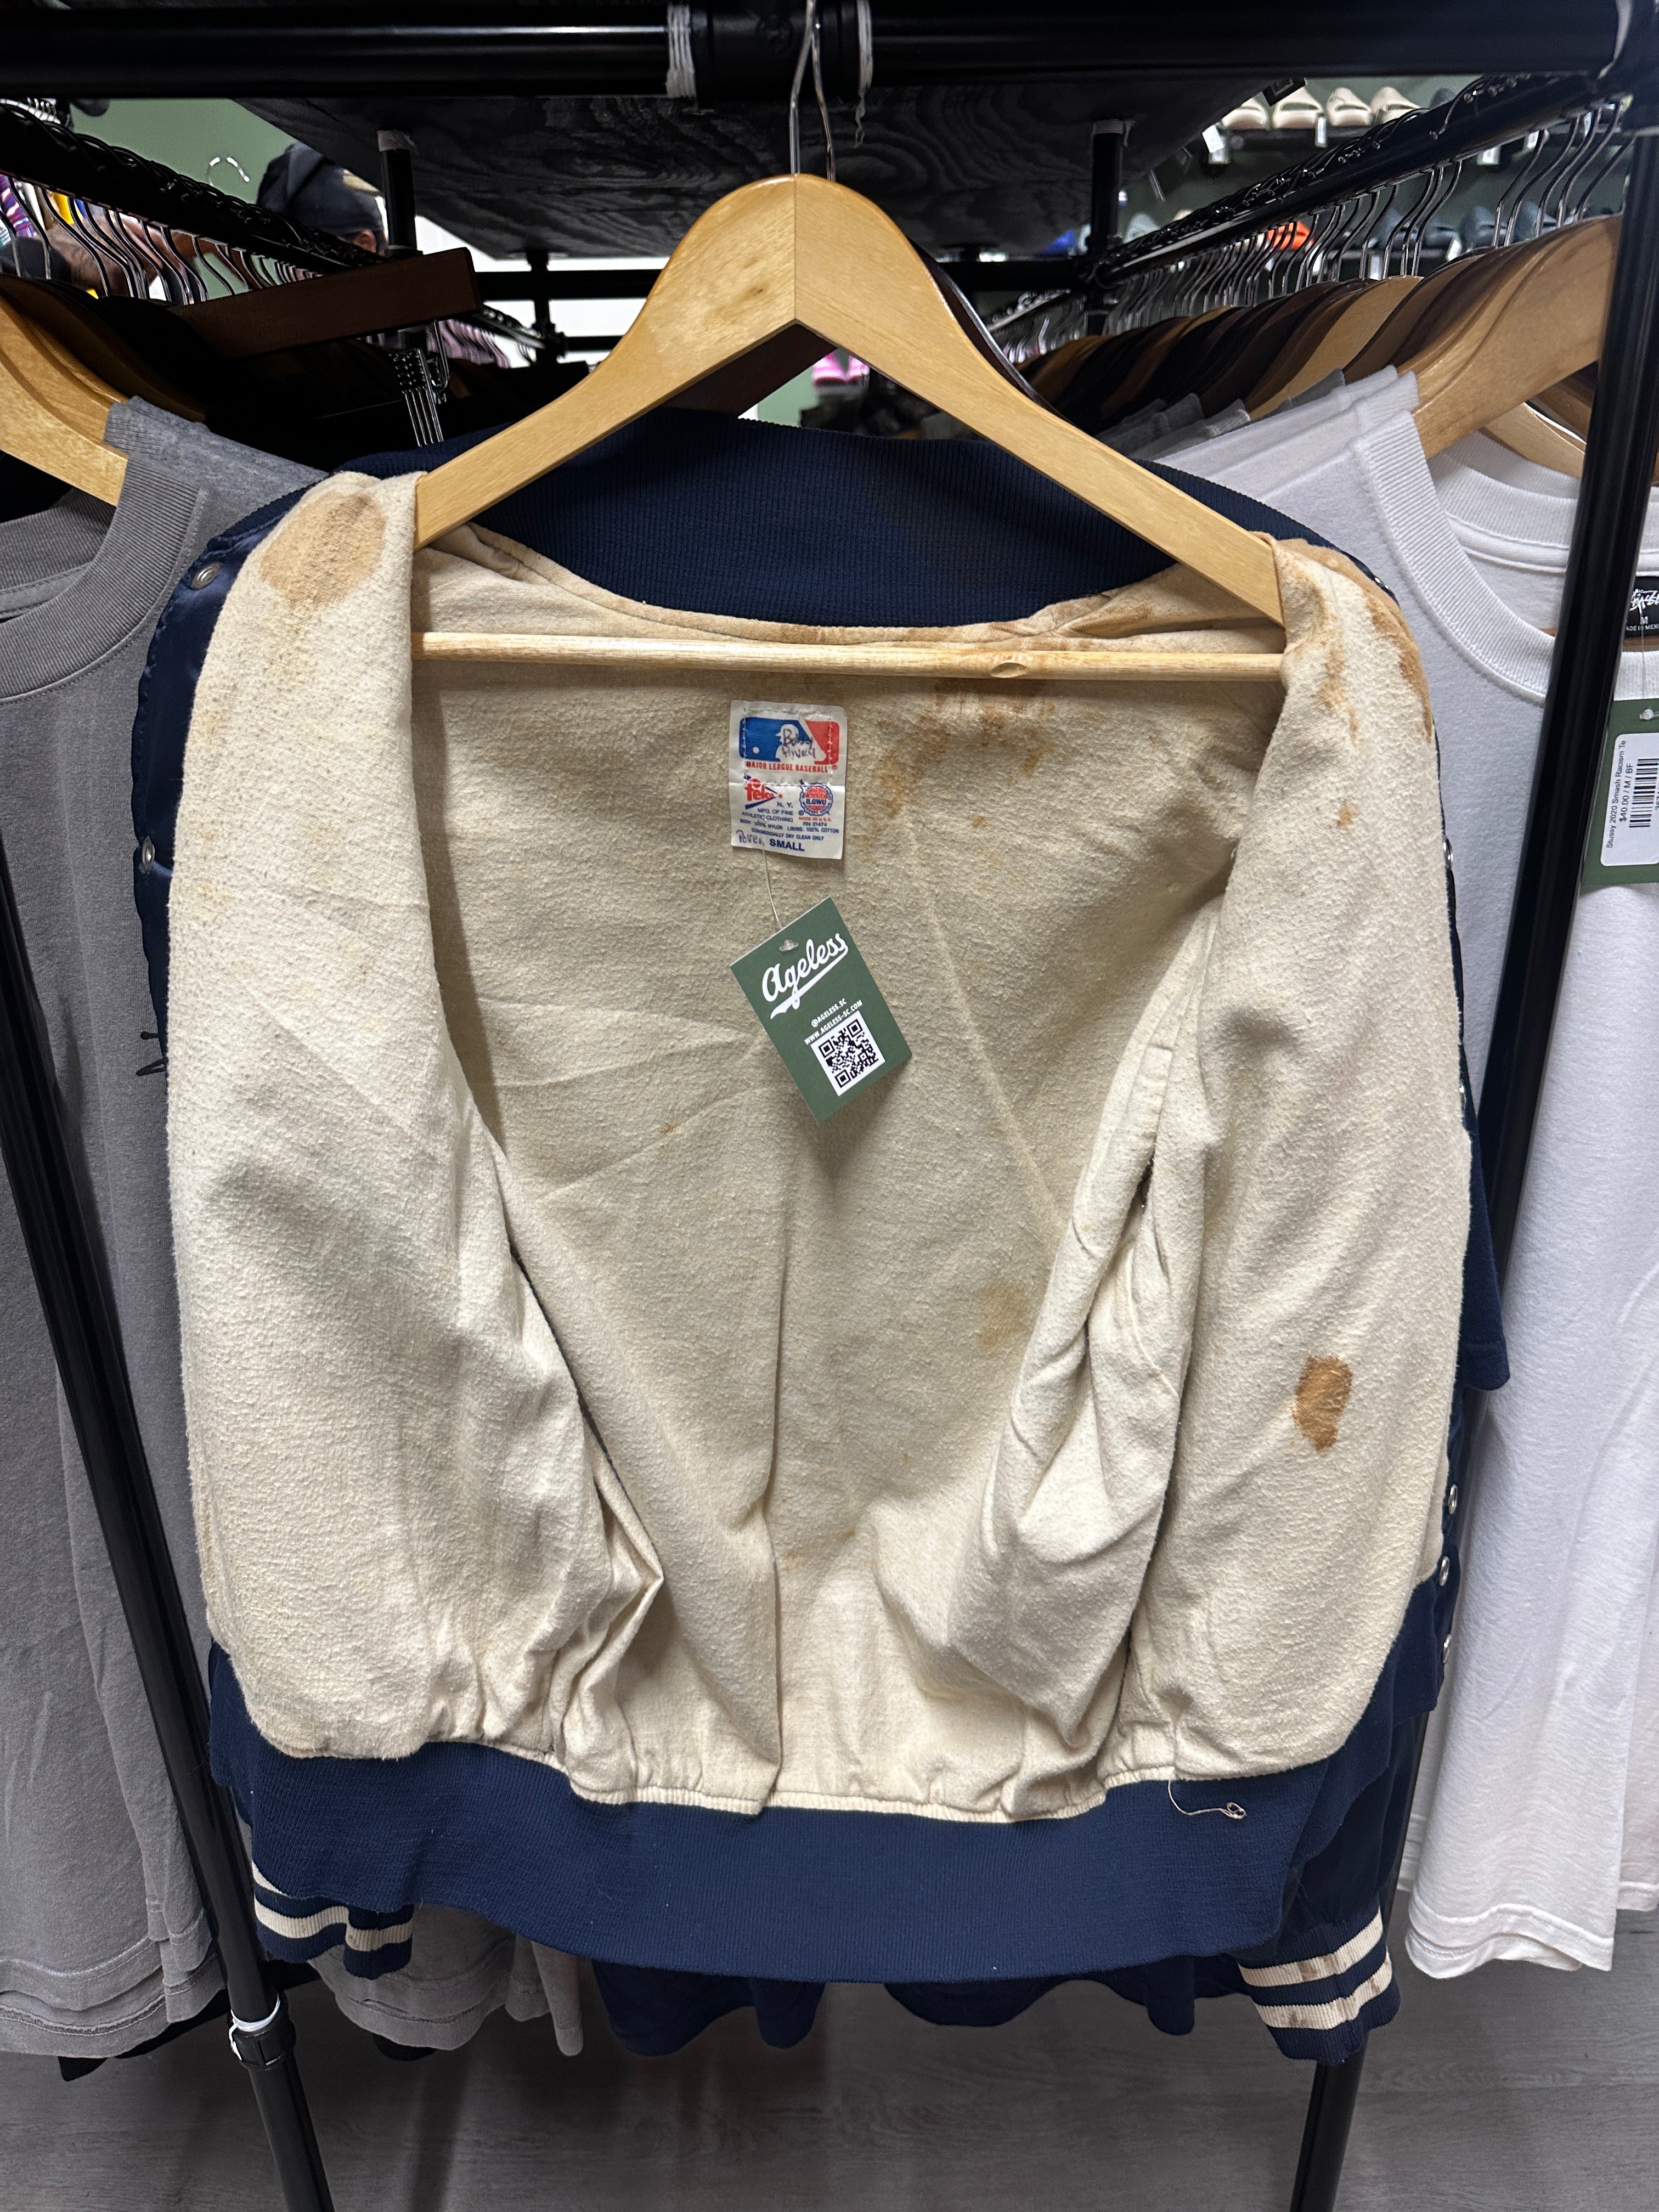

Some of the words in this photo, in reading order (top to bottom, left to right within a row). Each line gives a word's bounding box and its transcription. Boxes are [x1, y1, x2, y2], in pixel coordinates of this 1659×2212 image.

[1640, 616, 1648, 624] M
[746, 761, 767, 769] MAJOR
[795, 765, 828, 773] BASEBALL
[1615, 751, 1624, 777] Racism
[1612, 778, 1621, 804] Smash
[1619, 795, 1629, 822] $40.00
[1626, 763, 1633, 774] BF
[742, 812, 765, 820] ATHLETIC
[1610, 805, 1618, 823] 2020
[770, 838, 804, 851] SMALL
[1606, 824, 1617, 848] Stussy
[762, 933, 848, 1011] Ageless
[804, 1000, 863, 1045] WWW.AGELESS-SC.COM
[811, 998, 847, 1028] @AGELESS.SC
